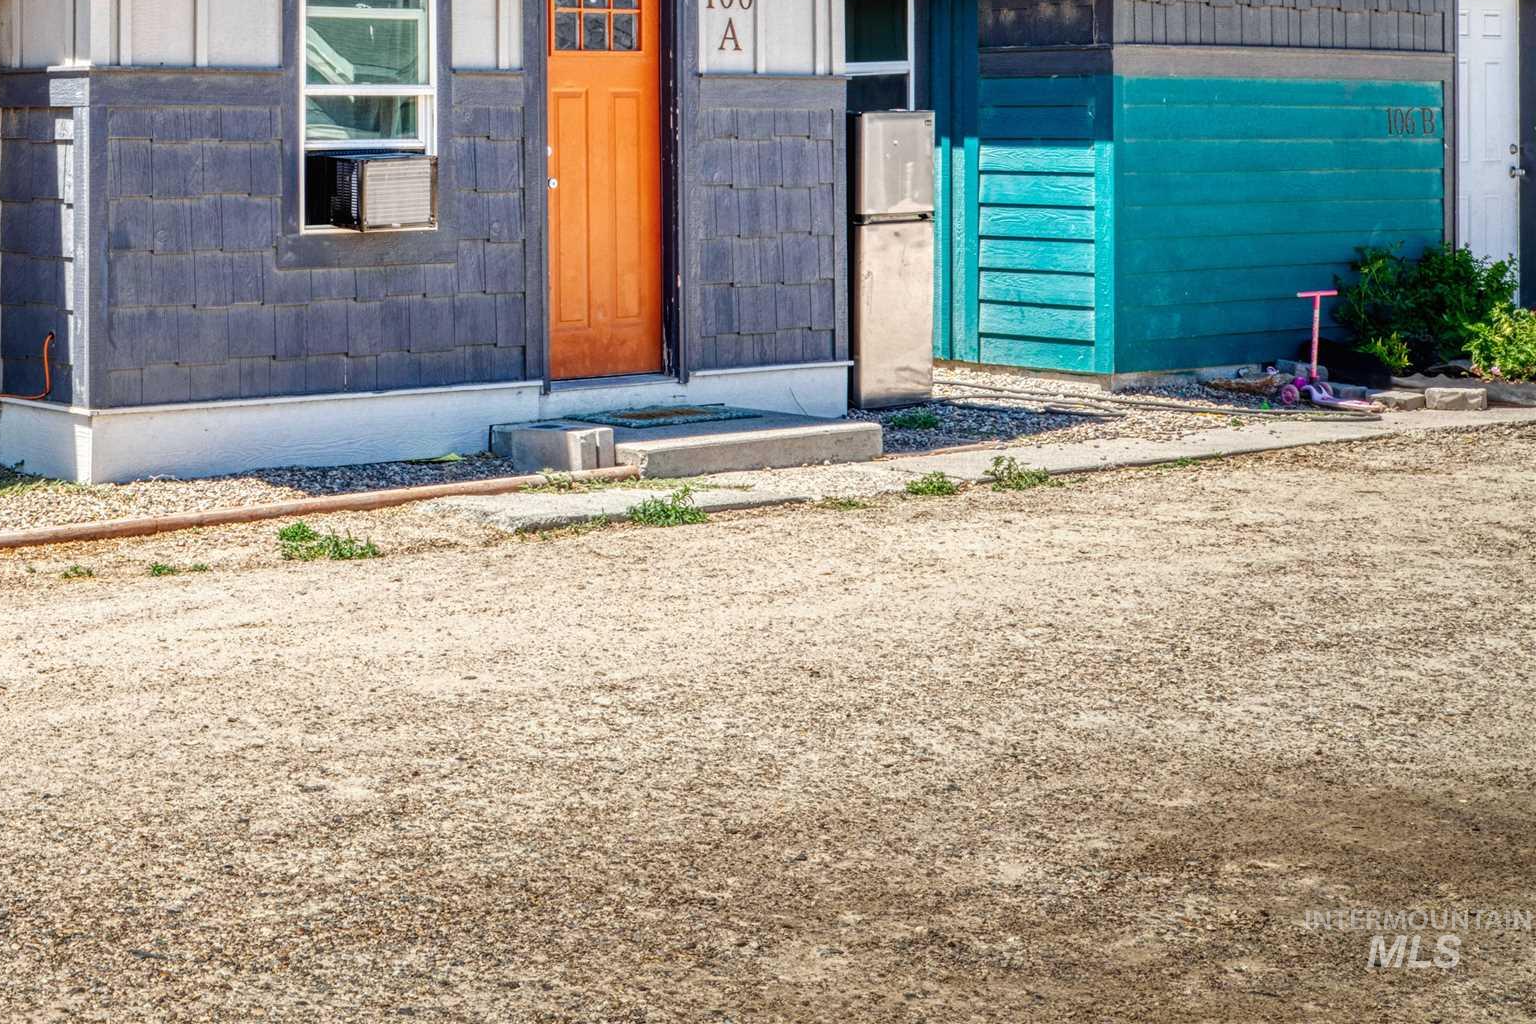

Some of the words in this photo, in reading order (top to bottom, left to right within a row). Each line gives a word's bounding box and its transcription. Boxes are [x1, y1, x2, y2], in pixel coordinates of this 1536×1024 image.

[718, 17, 743, 51] A
[1386, 106, 1416, 135] 106
[1421, 107, 1436, 135] B
